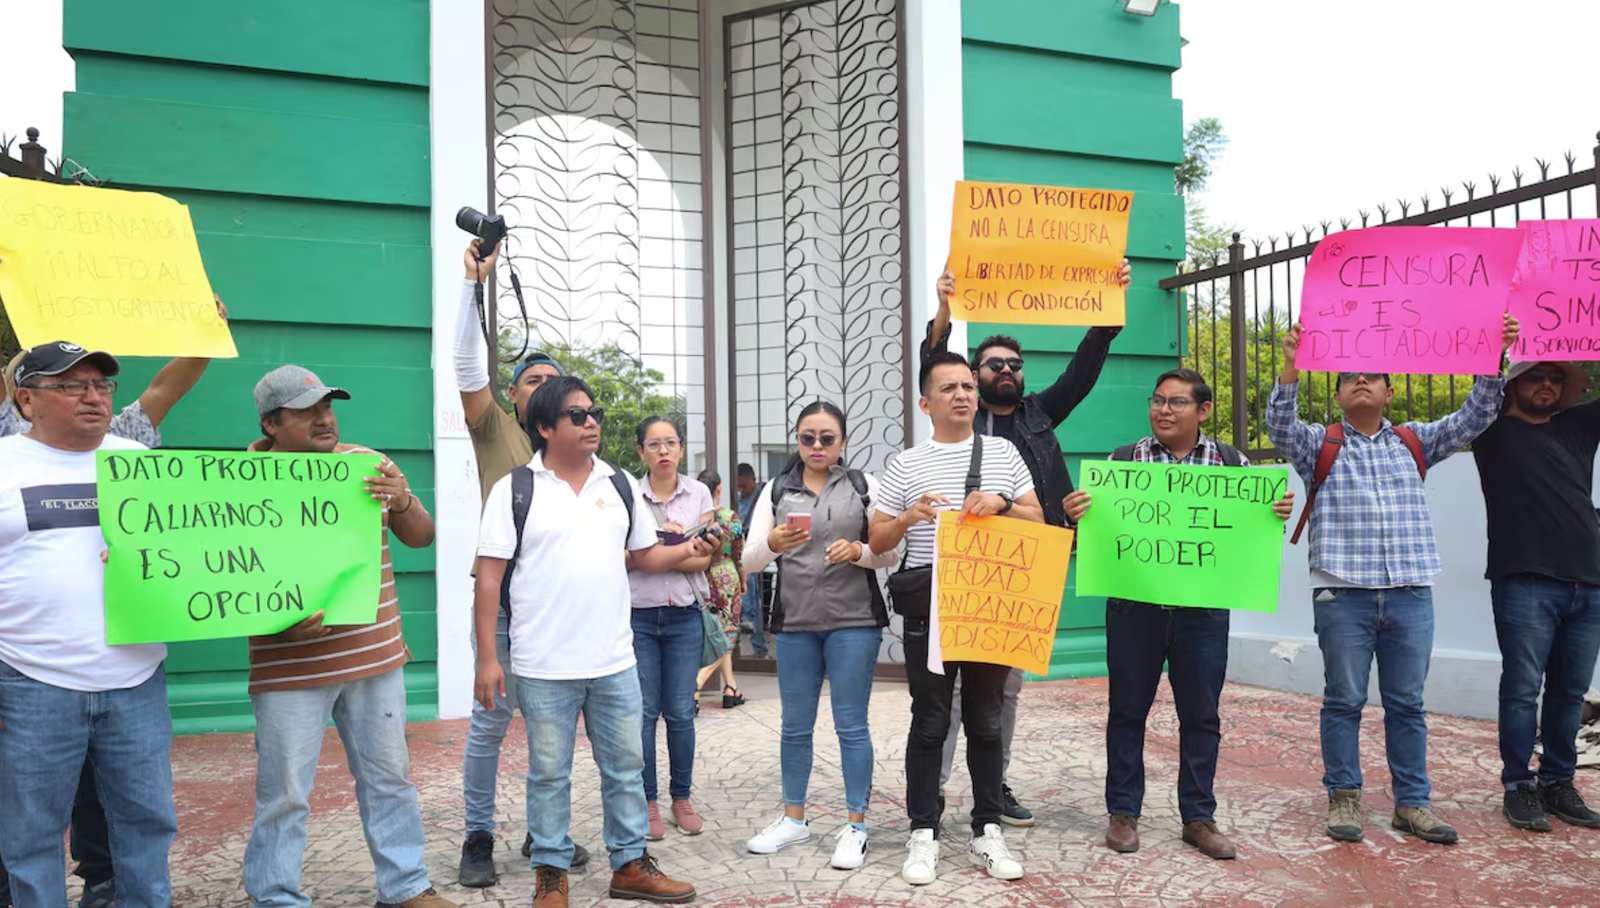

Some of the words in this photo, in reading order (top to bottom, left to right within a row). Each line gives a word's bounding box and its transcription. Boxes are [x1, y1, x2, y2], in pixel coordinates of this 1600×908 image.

[969, 186, 1022, 210] DATO
[1031, 187, 1129, 213] PROTEGIDO
[969, 217, 990, 238] NO
[998, 217, 1008, 238] A
[1016, 218, 1035, 239] LA
[1040, 219, 1112, 246] CENSURA
[964, 255, 1035, 280] LIBERTAD
[1040, 265, 1057, 281] DE
[1338, 253, 1490, 288] CENSURA
[963, 289, 998, 312] SIN
[1007, 289, 1103, 313] CONDICIÓN
[1370, 299, 1423, 329] ES
[1535, 290, 1600, 331] SIM
[1308, 327, 1493, 361] DICTADURA
[104, 455, 183, 482] DATO
[195, 455, 349, 483] PROTEGIDO
[1088, 467, 1152, 491] DATO
[1165, 467, 1288, 505] PROTEGIDO
[118, 497, 283, 535] CALLARNOS
[300, 496, 339, 528] NO
[1114, 497, 1171, 527] POR
[1188, 506, 1233, 530] EL
[137, 549, 182, 580] ES
[204, 545, 265, 574] UNA
[954, 527, 1026, 566] CALLA
[1115, 534, 1216, 568] PODER
[187, 580, 304, 622] OPCIÓN
